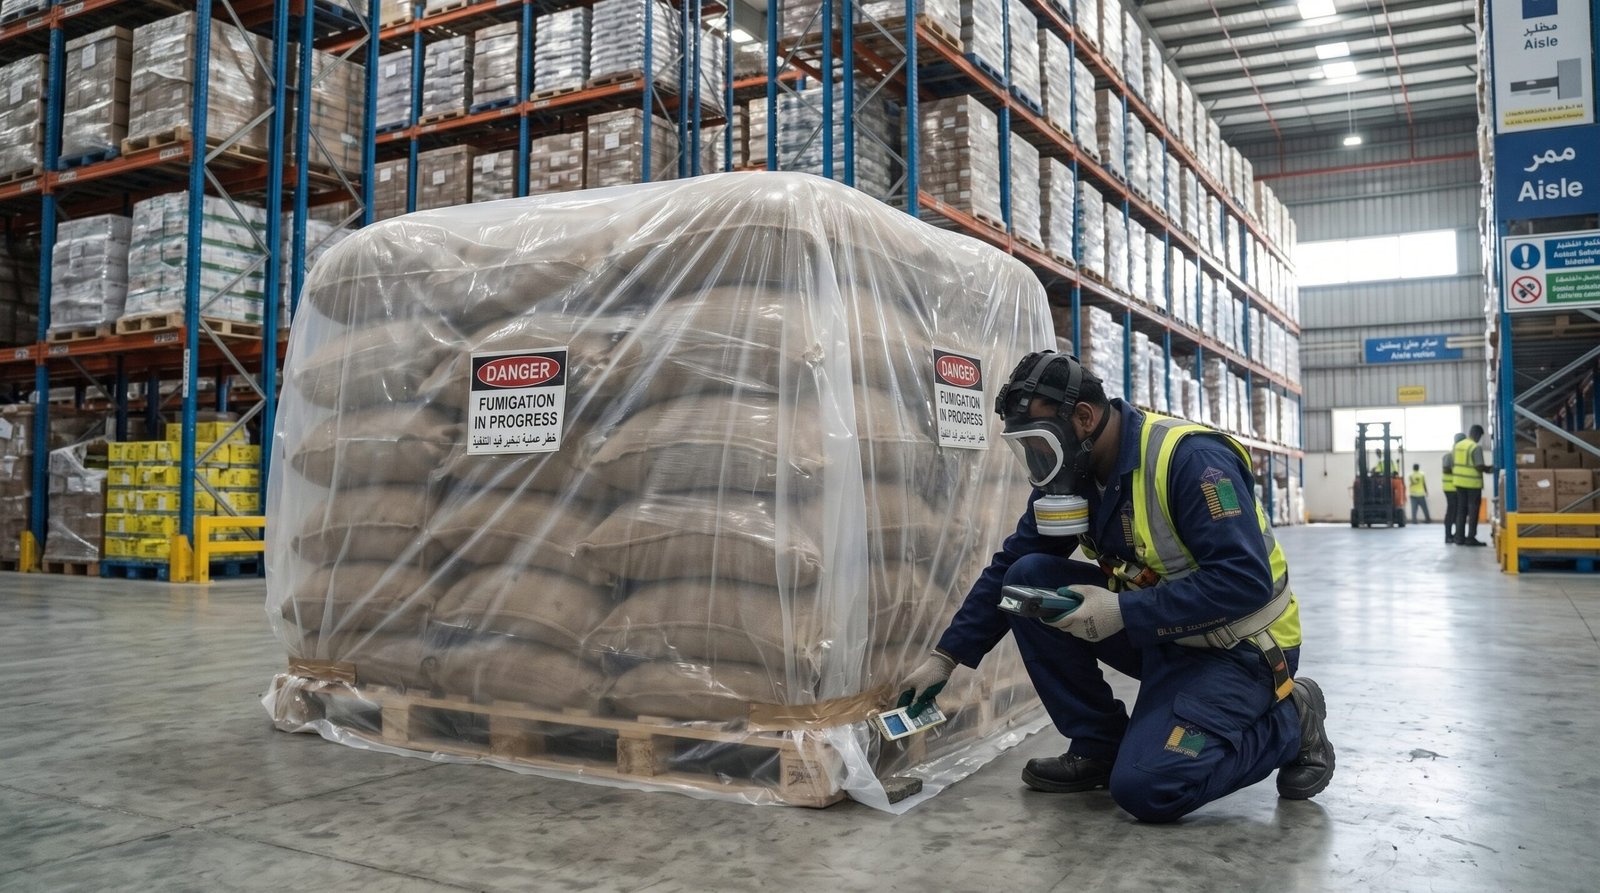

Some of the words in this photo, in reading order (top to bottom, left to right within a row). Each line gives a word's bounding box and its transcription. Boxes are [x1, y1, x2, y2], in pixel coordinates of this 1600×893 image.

[1524, 36, 1558, 50] Aisle
[1523, 147, 1576, 172] ممر
[1517, 177, 1583, 202] Aisle
[486, 362, 550, 382] DANGER
[941, 360, 975, 382] DANGER
[479, 393, 555, 411] FUMIGATION
[940, 390, 981, 410] FUMIGATION
[474, 416, 486, 430] IN
[489, 412, 558, 429] PROGRESS
[940, 408, 947, 422] IN
[948, 409, 983, 426] PROGRESS
[522, 433, 541, 447] عملية
[541, 432, 557, 446] خطر
